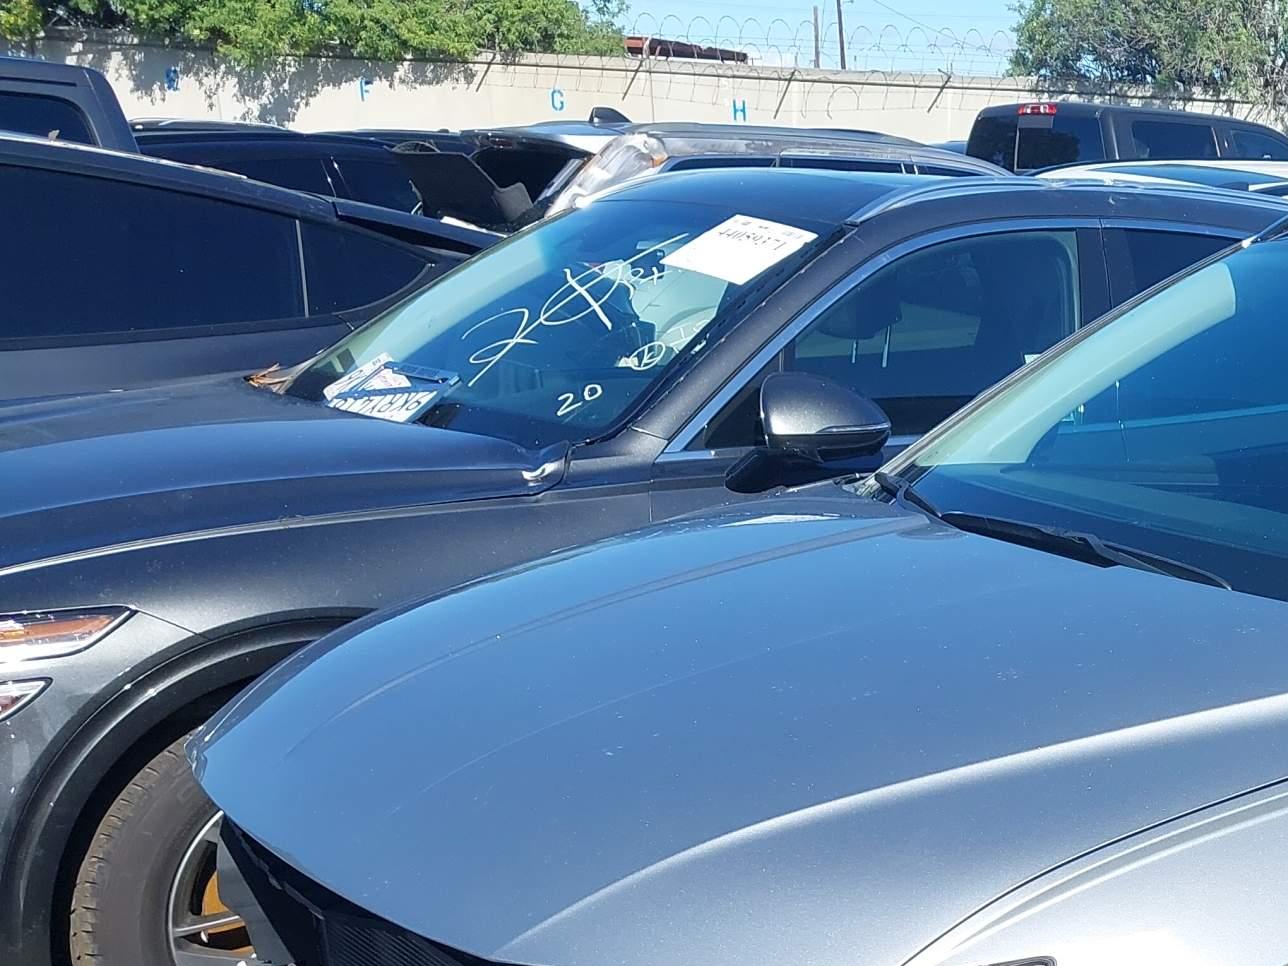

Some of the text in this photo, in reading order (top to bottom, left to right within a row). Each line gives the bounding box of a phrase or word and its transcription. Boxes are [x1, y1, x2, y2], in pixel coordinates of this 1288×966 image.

[360, 78, 373, 101] F
[551, 89, 565, 111] G
[732, 99, 746, 121] H
[557, 384, 603, 416] 20
